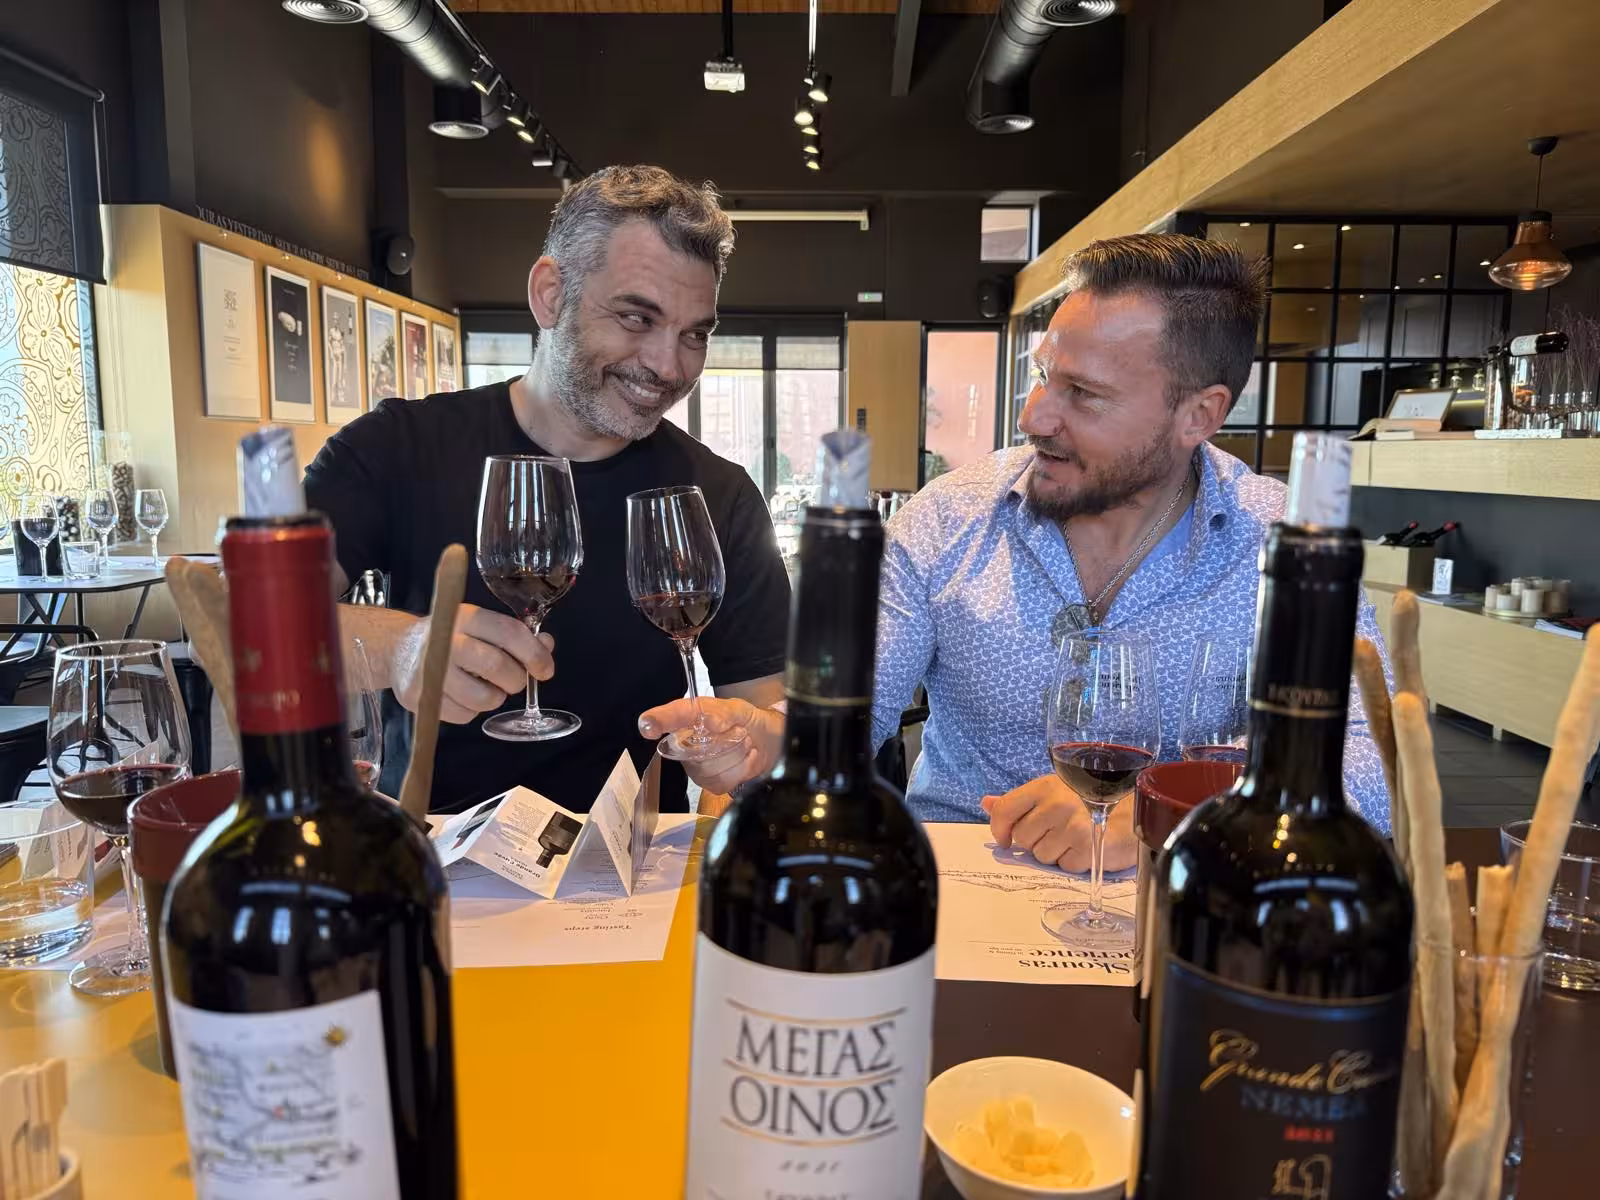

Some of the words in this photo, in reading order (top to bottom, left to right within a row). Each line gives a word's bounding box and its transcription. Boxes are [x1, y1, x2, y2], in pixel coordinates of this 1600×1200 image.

[1018, 959, 1131, 974] Skouras
[735, 1015, 897, 1077] ΜΕΓΑΣ
[729, 1075, 896, 1137] ΟΙΝΟΣ
